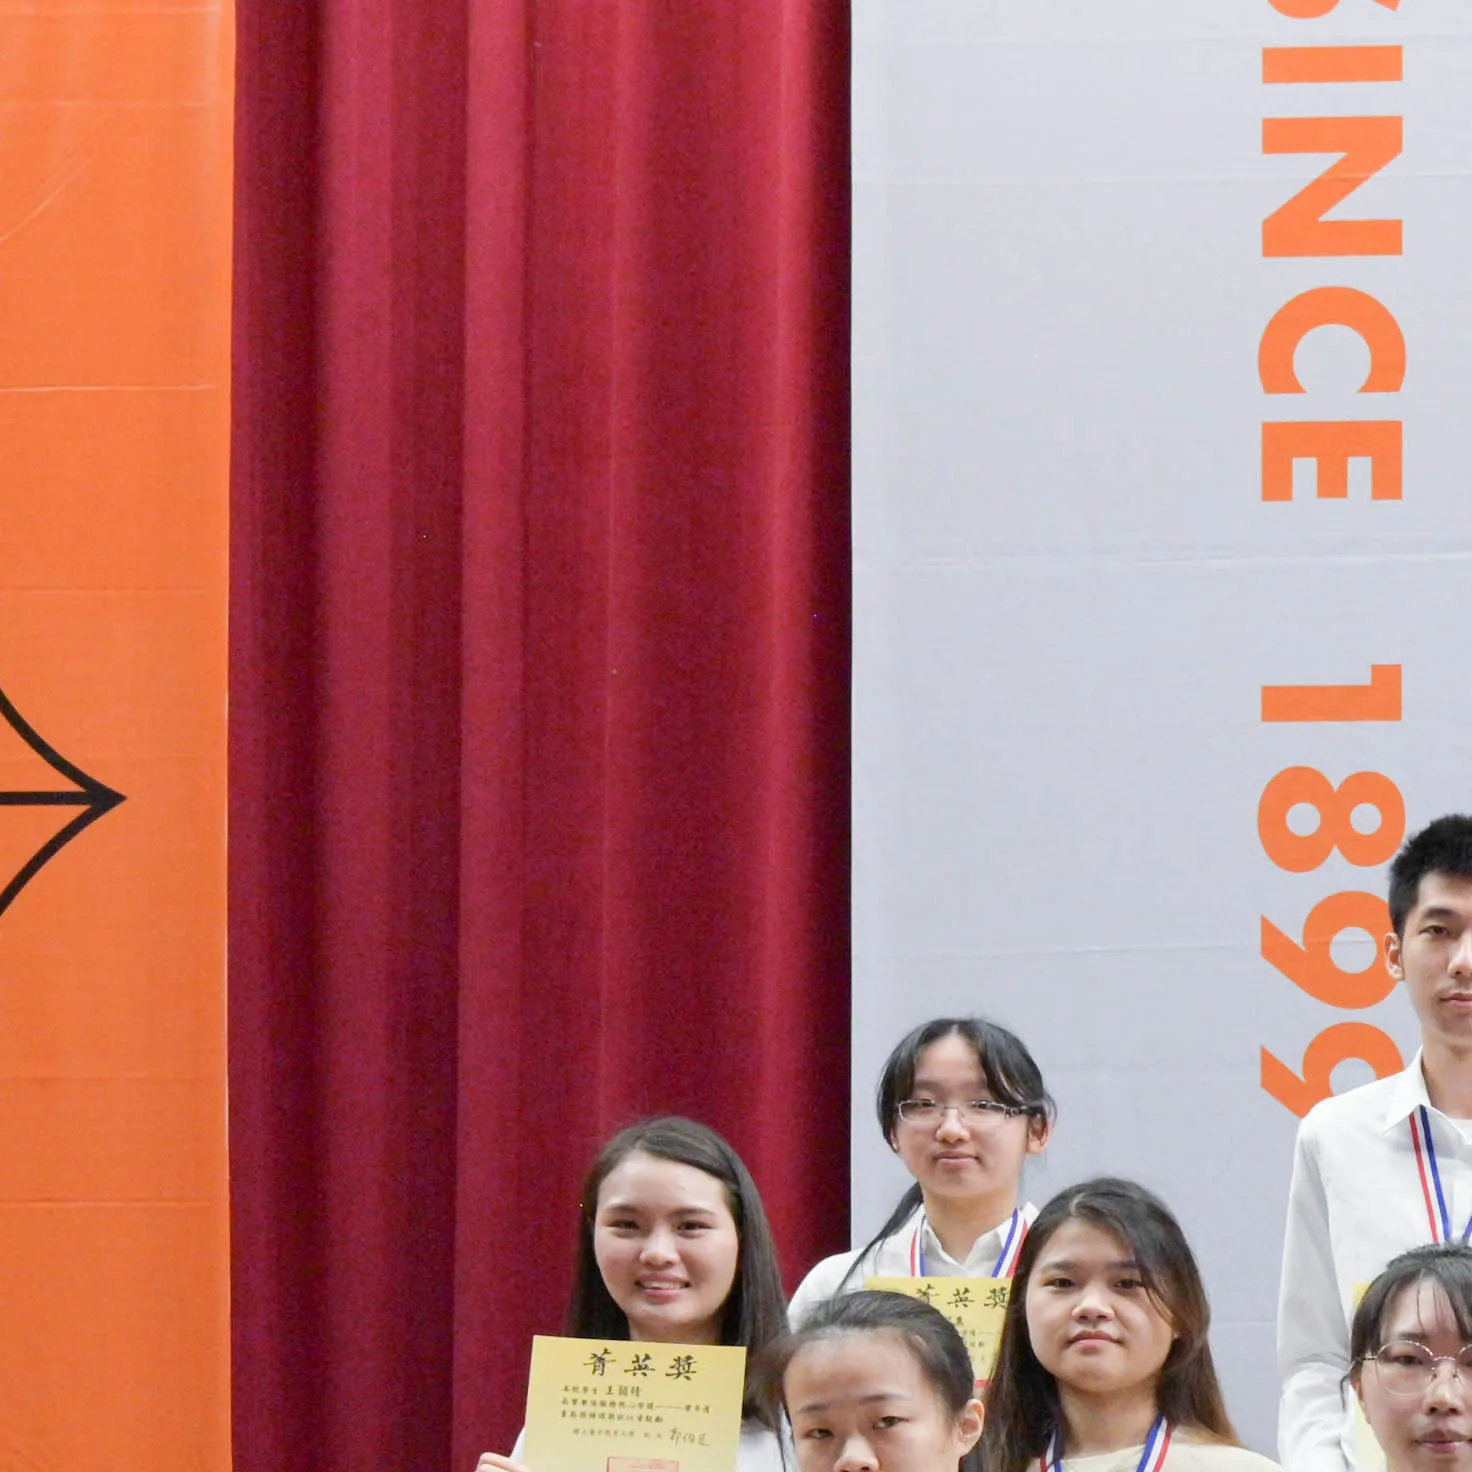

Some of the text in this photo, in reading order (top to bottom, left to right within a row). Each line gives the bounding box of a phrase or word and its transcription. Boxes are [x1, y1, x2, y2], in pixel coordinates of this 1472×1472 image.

[1257, 0, 1406, 1119] INCE 1899
[583, 1347, 697, 1380] 菁英獎
